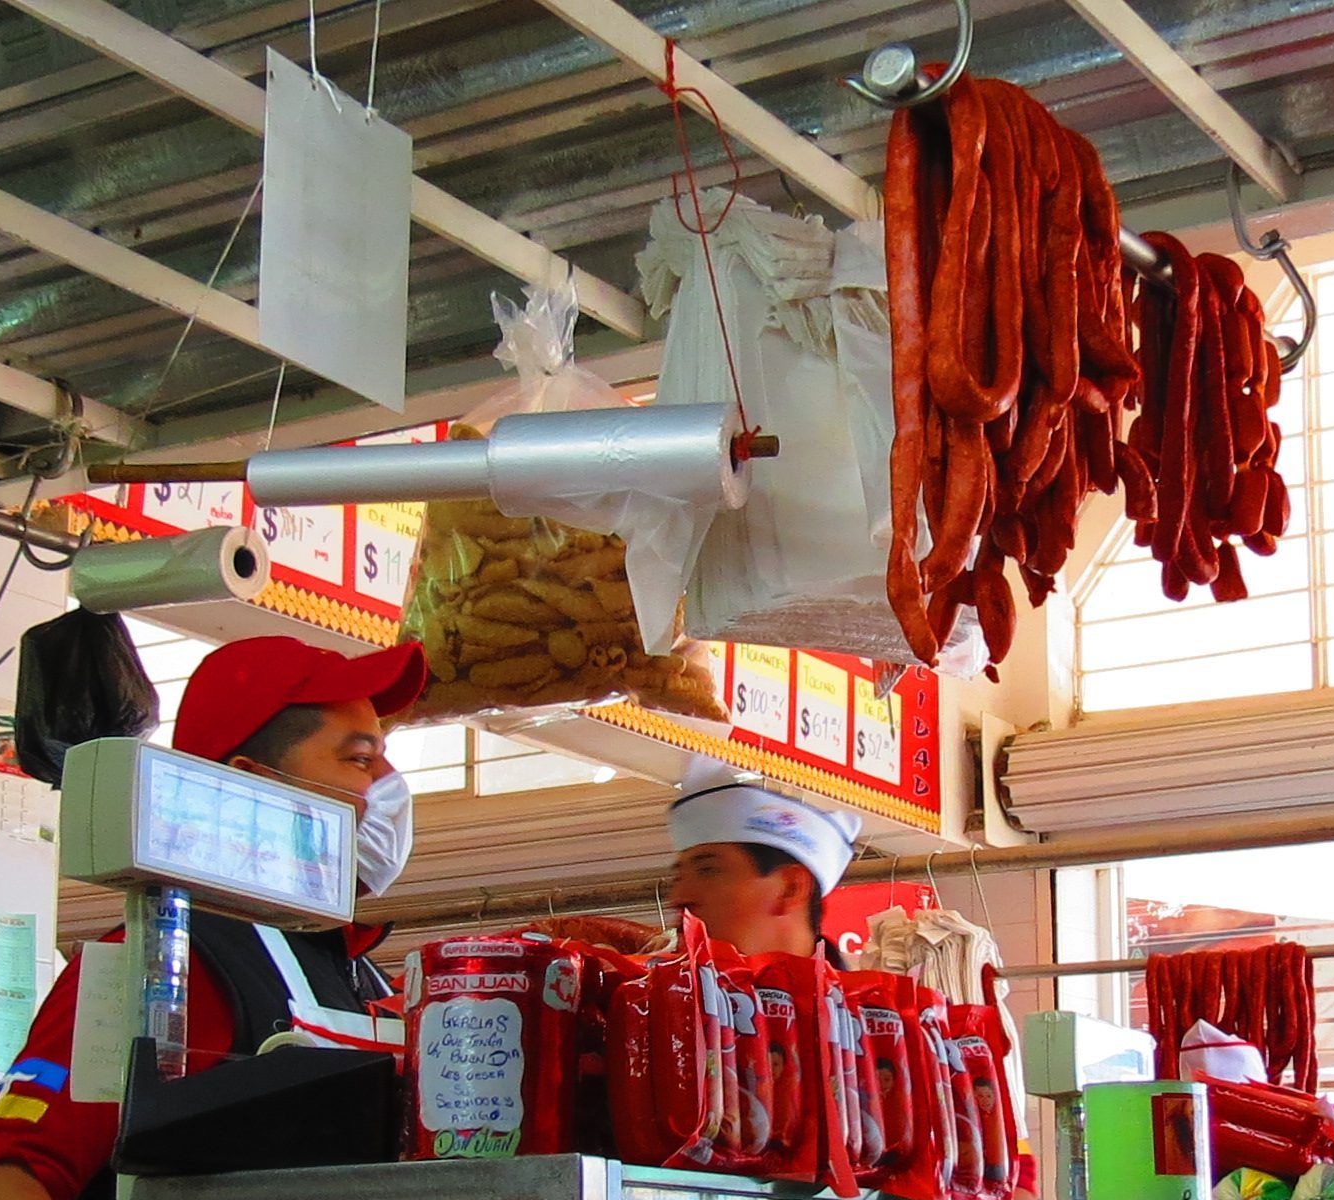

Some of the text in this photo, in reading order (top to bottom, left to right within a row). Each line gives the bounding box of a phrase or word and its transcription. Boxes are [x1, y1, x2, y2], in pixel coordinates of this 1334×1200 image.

[369, 508, 387, 527] DE
[429, 975, 527, 992] SAN JUAN
